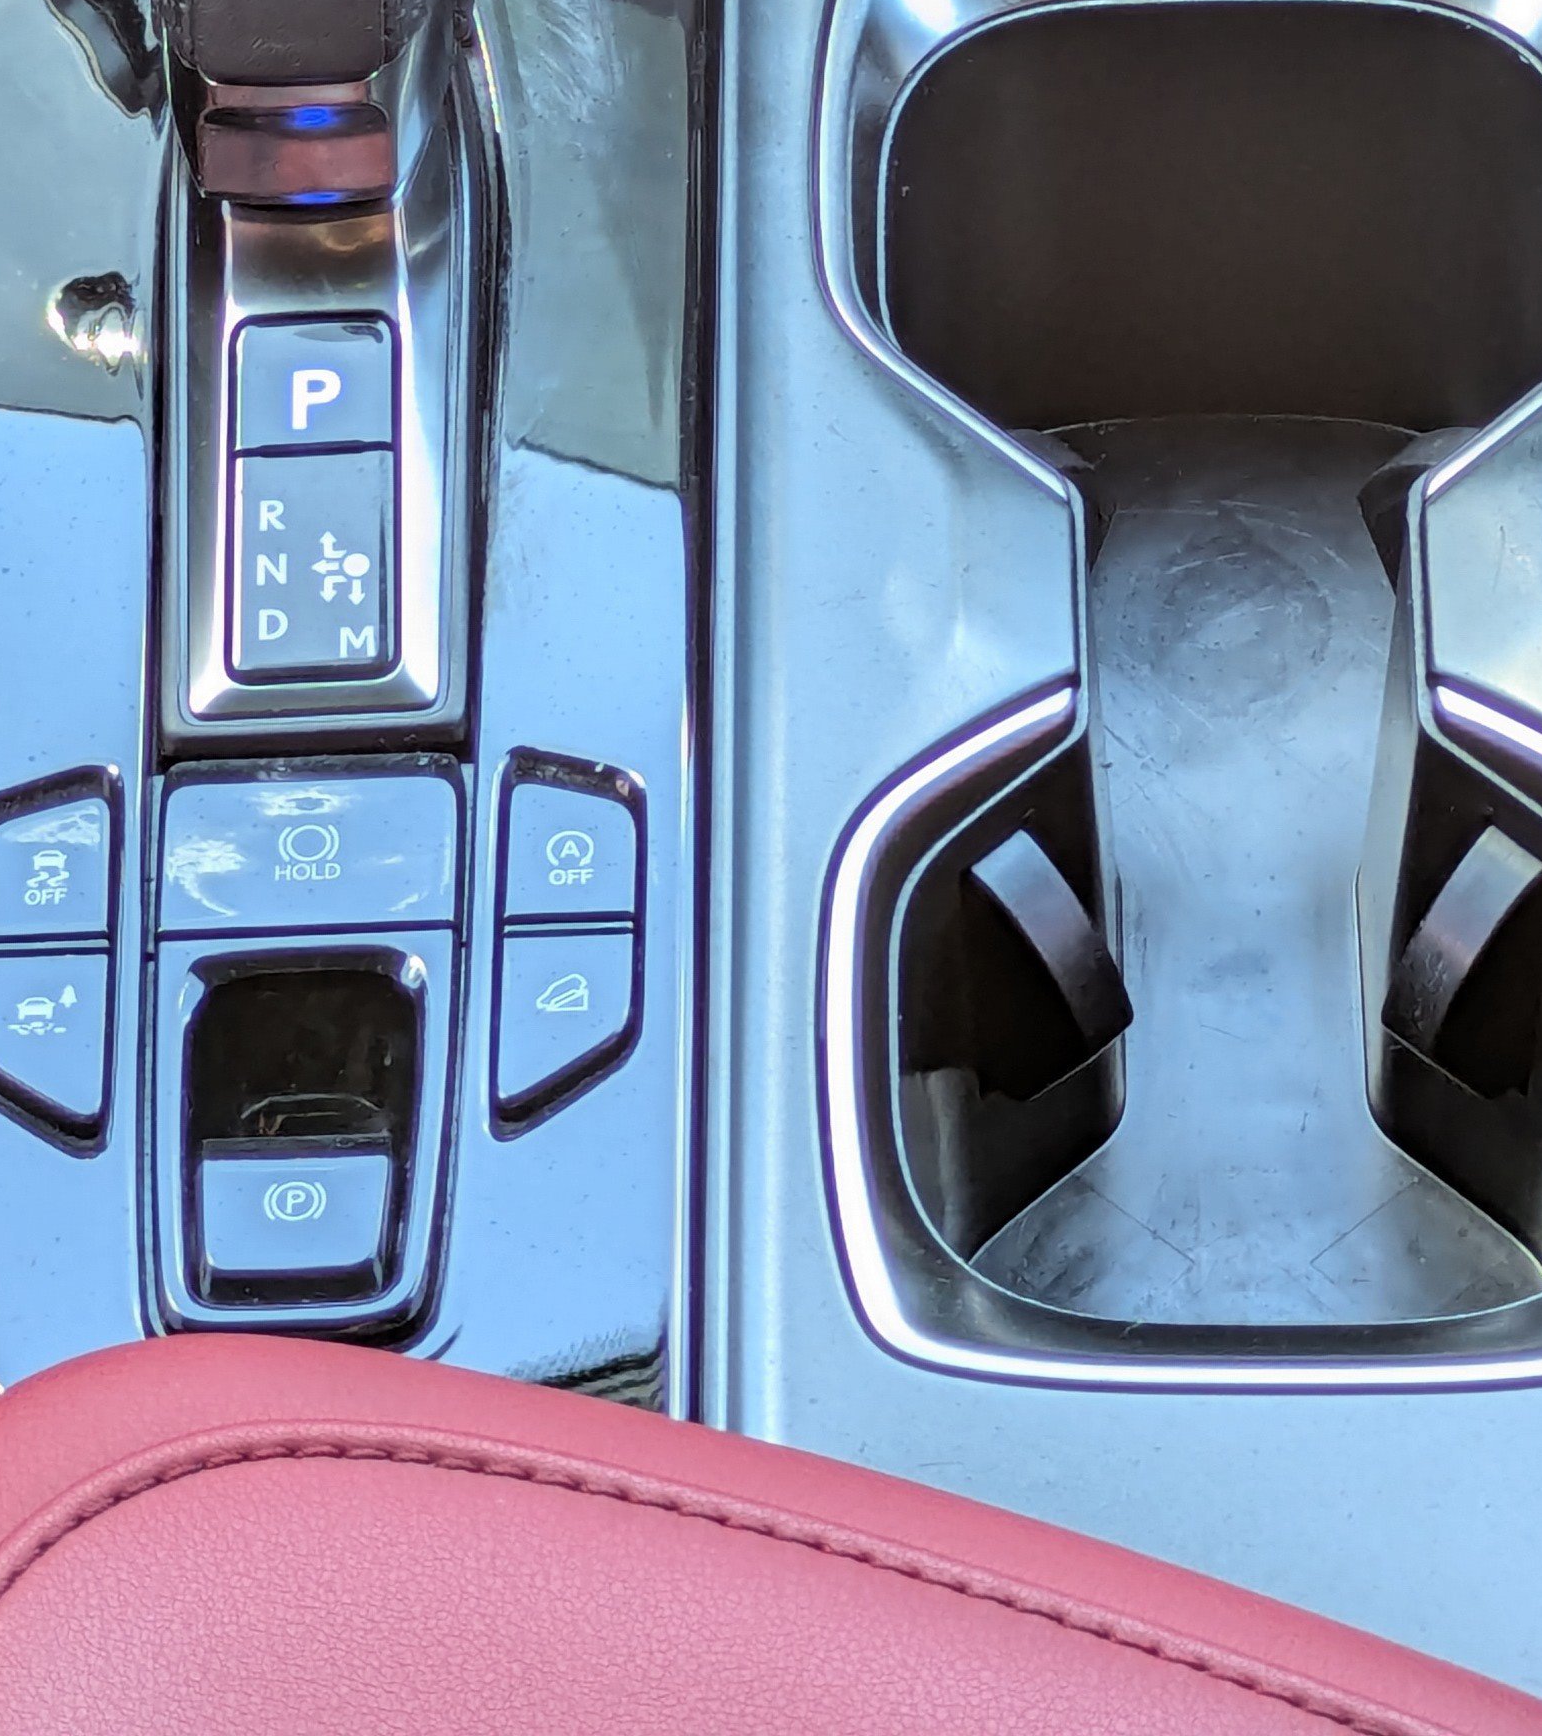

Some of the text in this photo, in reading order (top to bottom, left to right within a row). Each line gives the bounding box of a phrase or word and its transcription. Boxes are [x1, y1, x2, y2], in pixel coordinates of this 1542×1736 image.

[291, 369, 341, 430] P
[259, 500, 287, 531] R
[256, 553, 288, 585] N
[259, 609, 289, 641] D
[339, 625, 377, 658] M
[274, 862, 341, 881] HOLD
[548, 868, 594, 885] OFF
[24, 888, 68, 905] OFF
